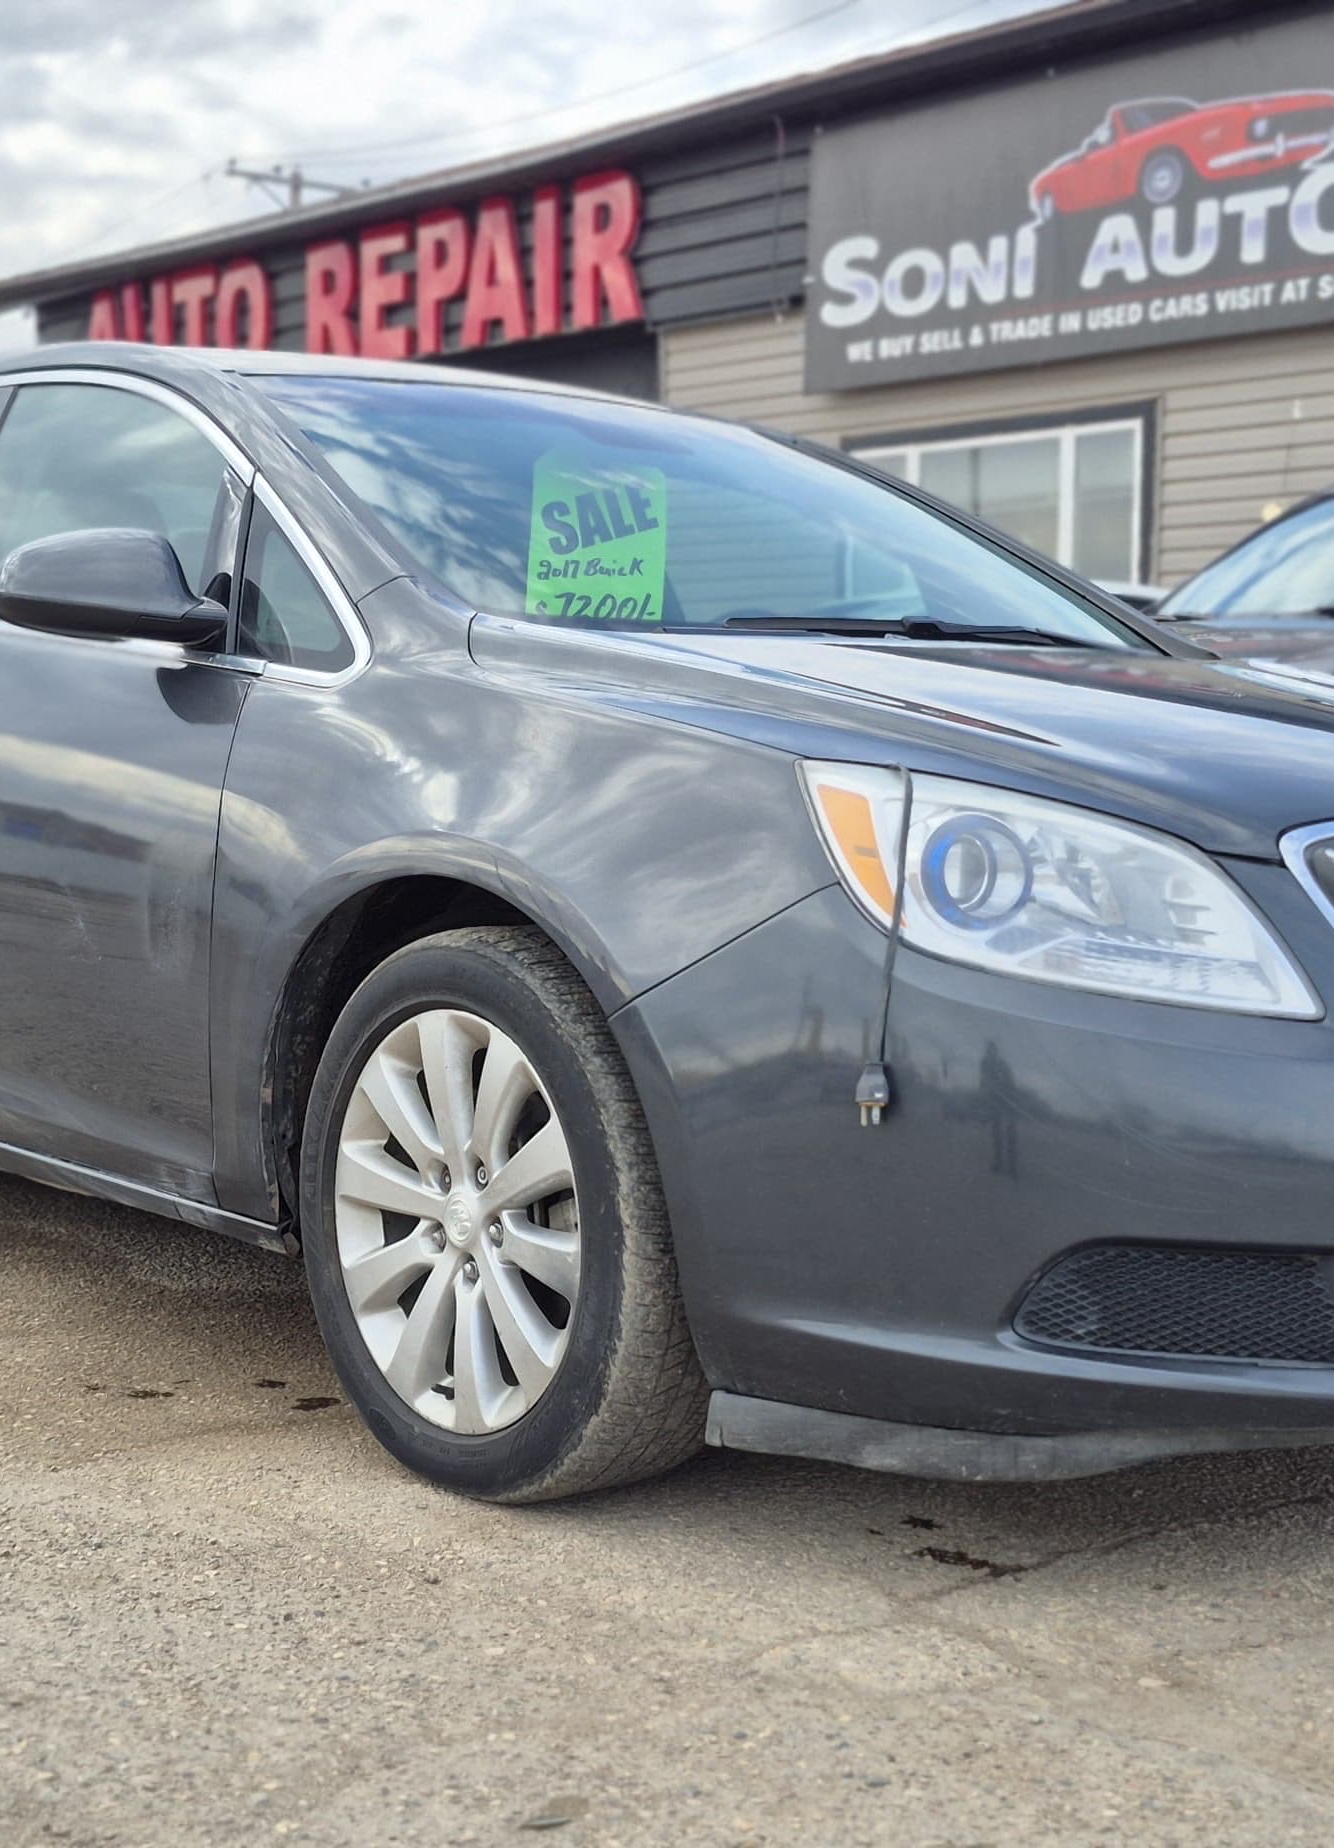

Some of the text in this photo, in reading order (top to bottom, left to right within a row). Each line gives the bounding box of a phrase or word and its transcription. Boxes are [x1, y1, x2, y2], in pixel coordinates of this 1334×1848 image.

[88, 169, 644, 361] AUTO REPAIR
[846, 341, 873, 363] WE
[879, 335, 914, 359] BUY
[921, 329, 962, 353] SELL
[970, 324, 984, 347] &
[990, 317, 1052, 344] TRADE
[1059, 311, 1082, 333] IN
[1087, 304, 1142, 330] USED
[1149, 293, 1209, 320] CARS
[1215, 283, 1275, 313] VISIT
[1281, 277, 1310, 304] AT
[540, 486, 660, 555] SALE
[536, 560, 580, 581] 2017
